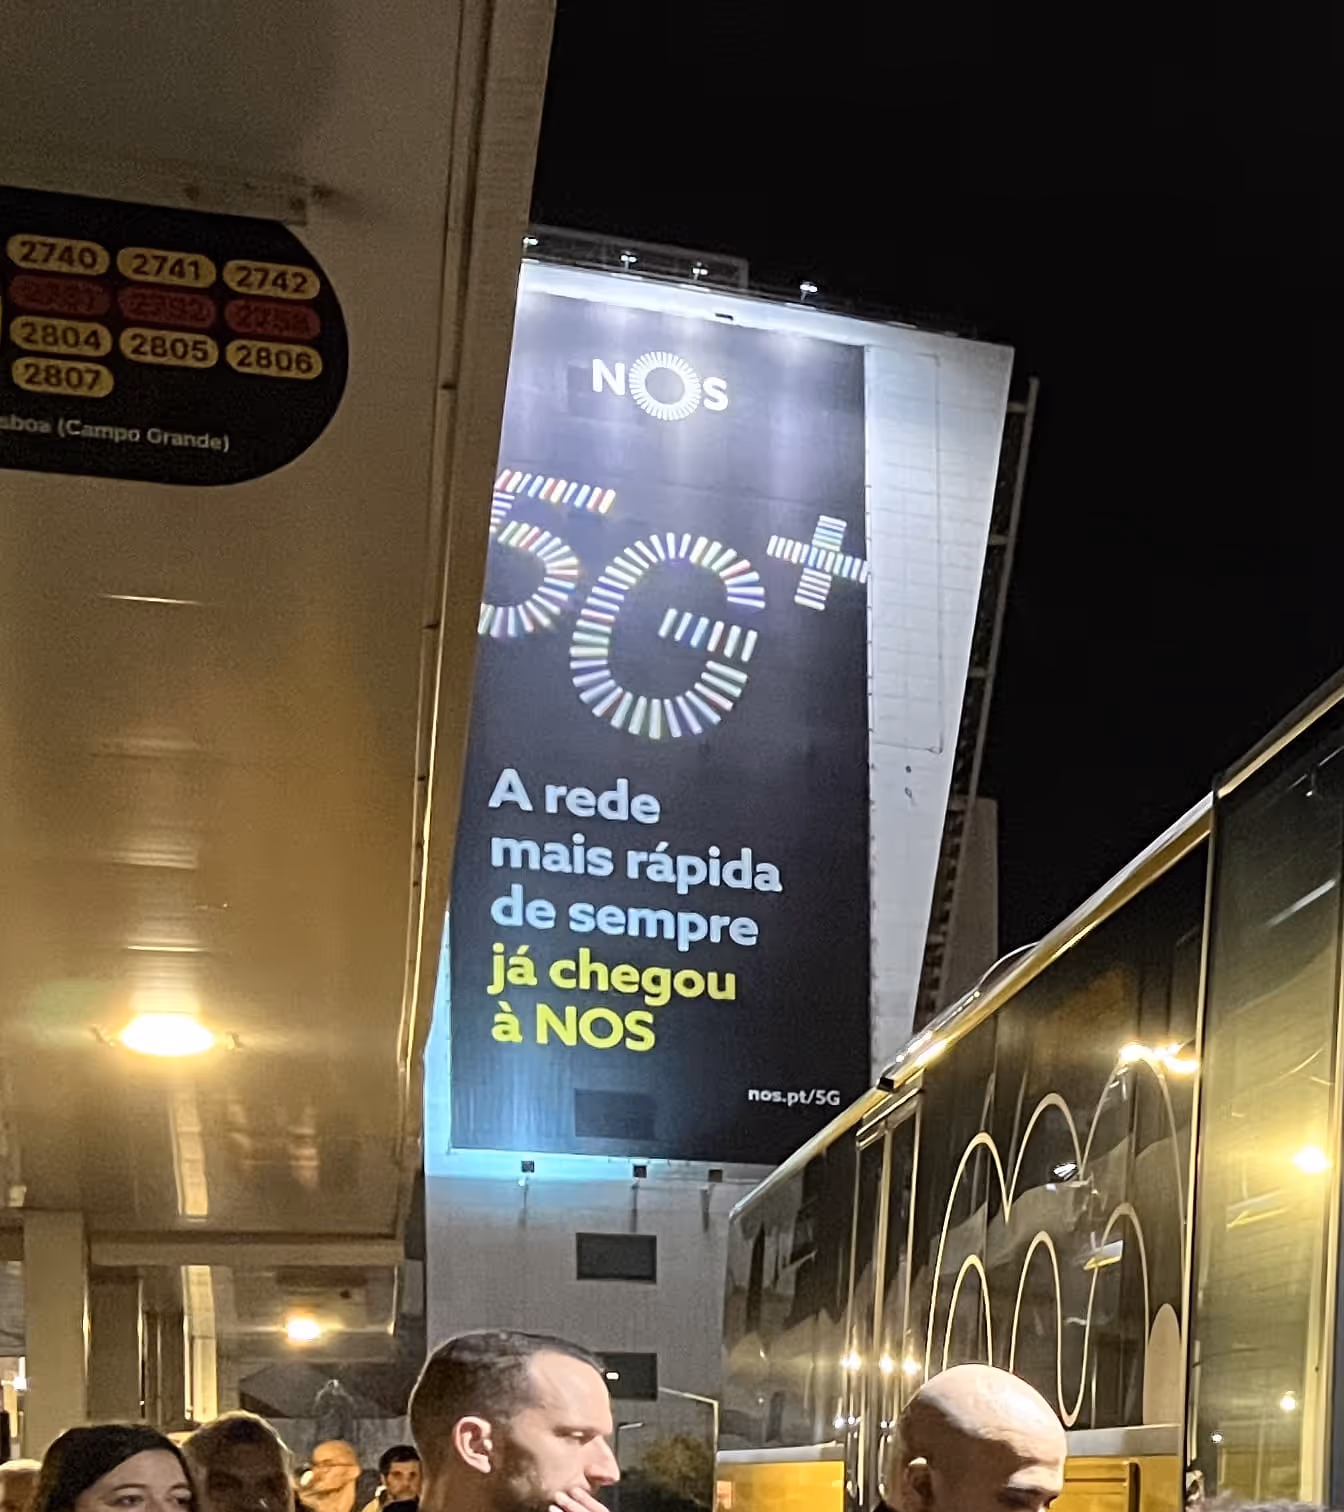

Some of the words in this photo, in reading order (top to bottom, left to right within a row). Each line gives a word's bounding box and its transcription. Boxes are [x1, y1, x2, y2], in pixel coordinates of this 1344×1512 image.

[20, 239, 98, 270] 2740
[131, 252, 200, 281] 2741
[237, 266, 308, 294] 2742
[22, 322, 101, 349] 2804
[130, 333, 209, 363] 2805
[236, 344, 313, 374] 2806
[24, 362, 100, 391] 2807
[591, 351, 729, 421] NOS
[58, 417, 140, 443] (Campo
[146, 427, 230, 452] Grande)
[488, 768, 533, 813] A
[545, 777, 661, 824] rede
[490, 832, 613, 877] mais
[626, 841, 783, 896] rápida
[490, 884, 556, 930] de
[569, 902, 760, 952] sempre
[488, 943, 537, 995] já
[548, 947, 737, 1007] chegou
[490, 1002, 522, 1045] à
[536, 1005, 657, 1052] NOS
[748, 1086, 841, 1107] nos.pt/5G
